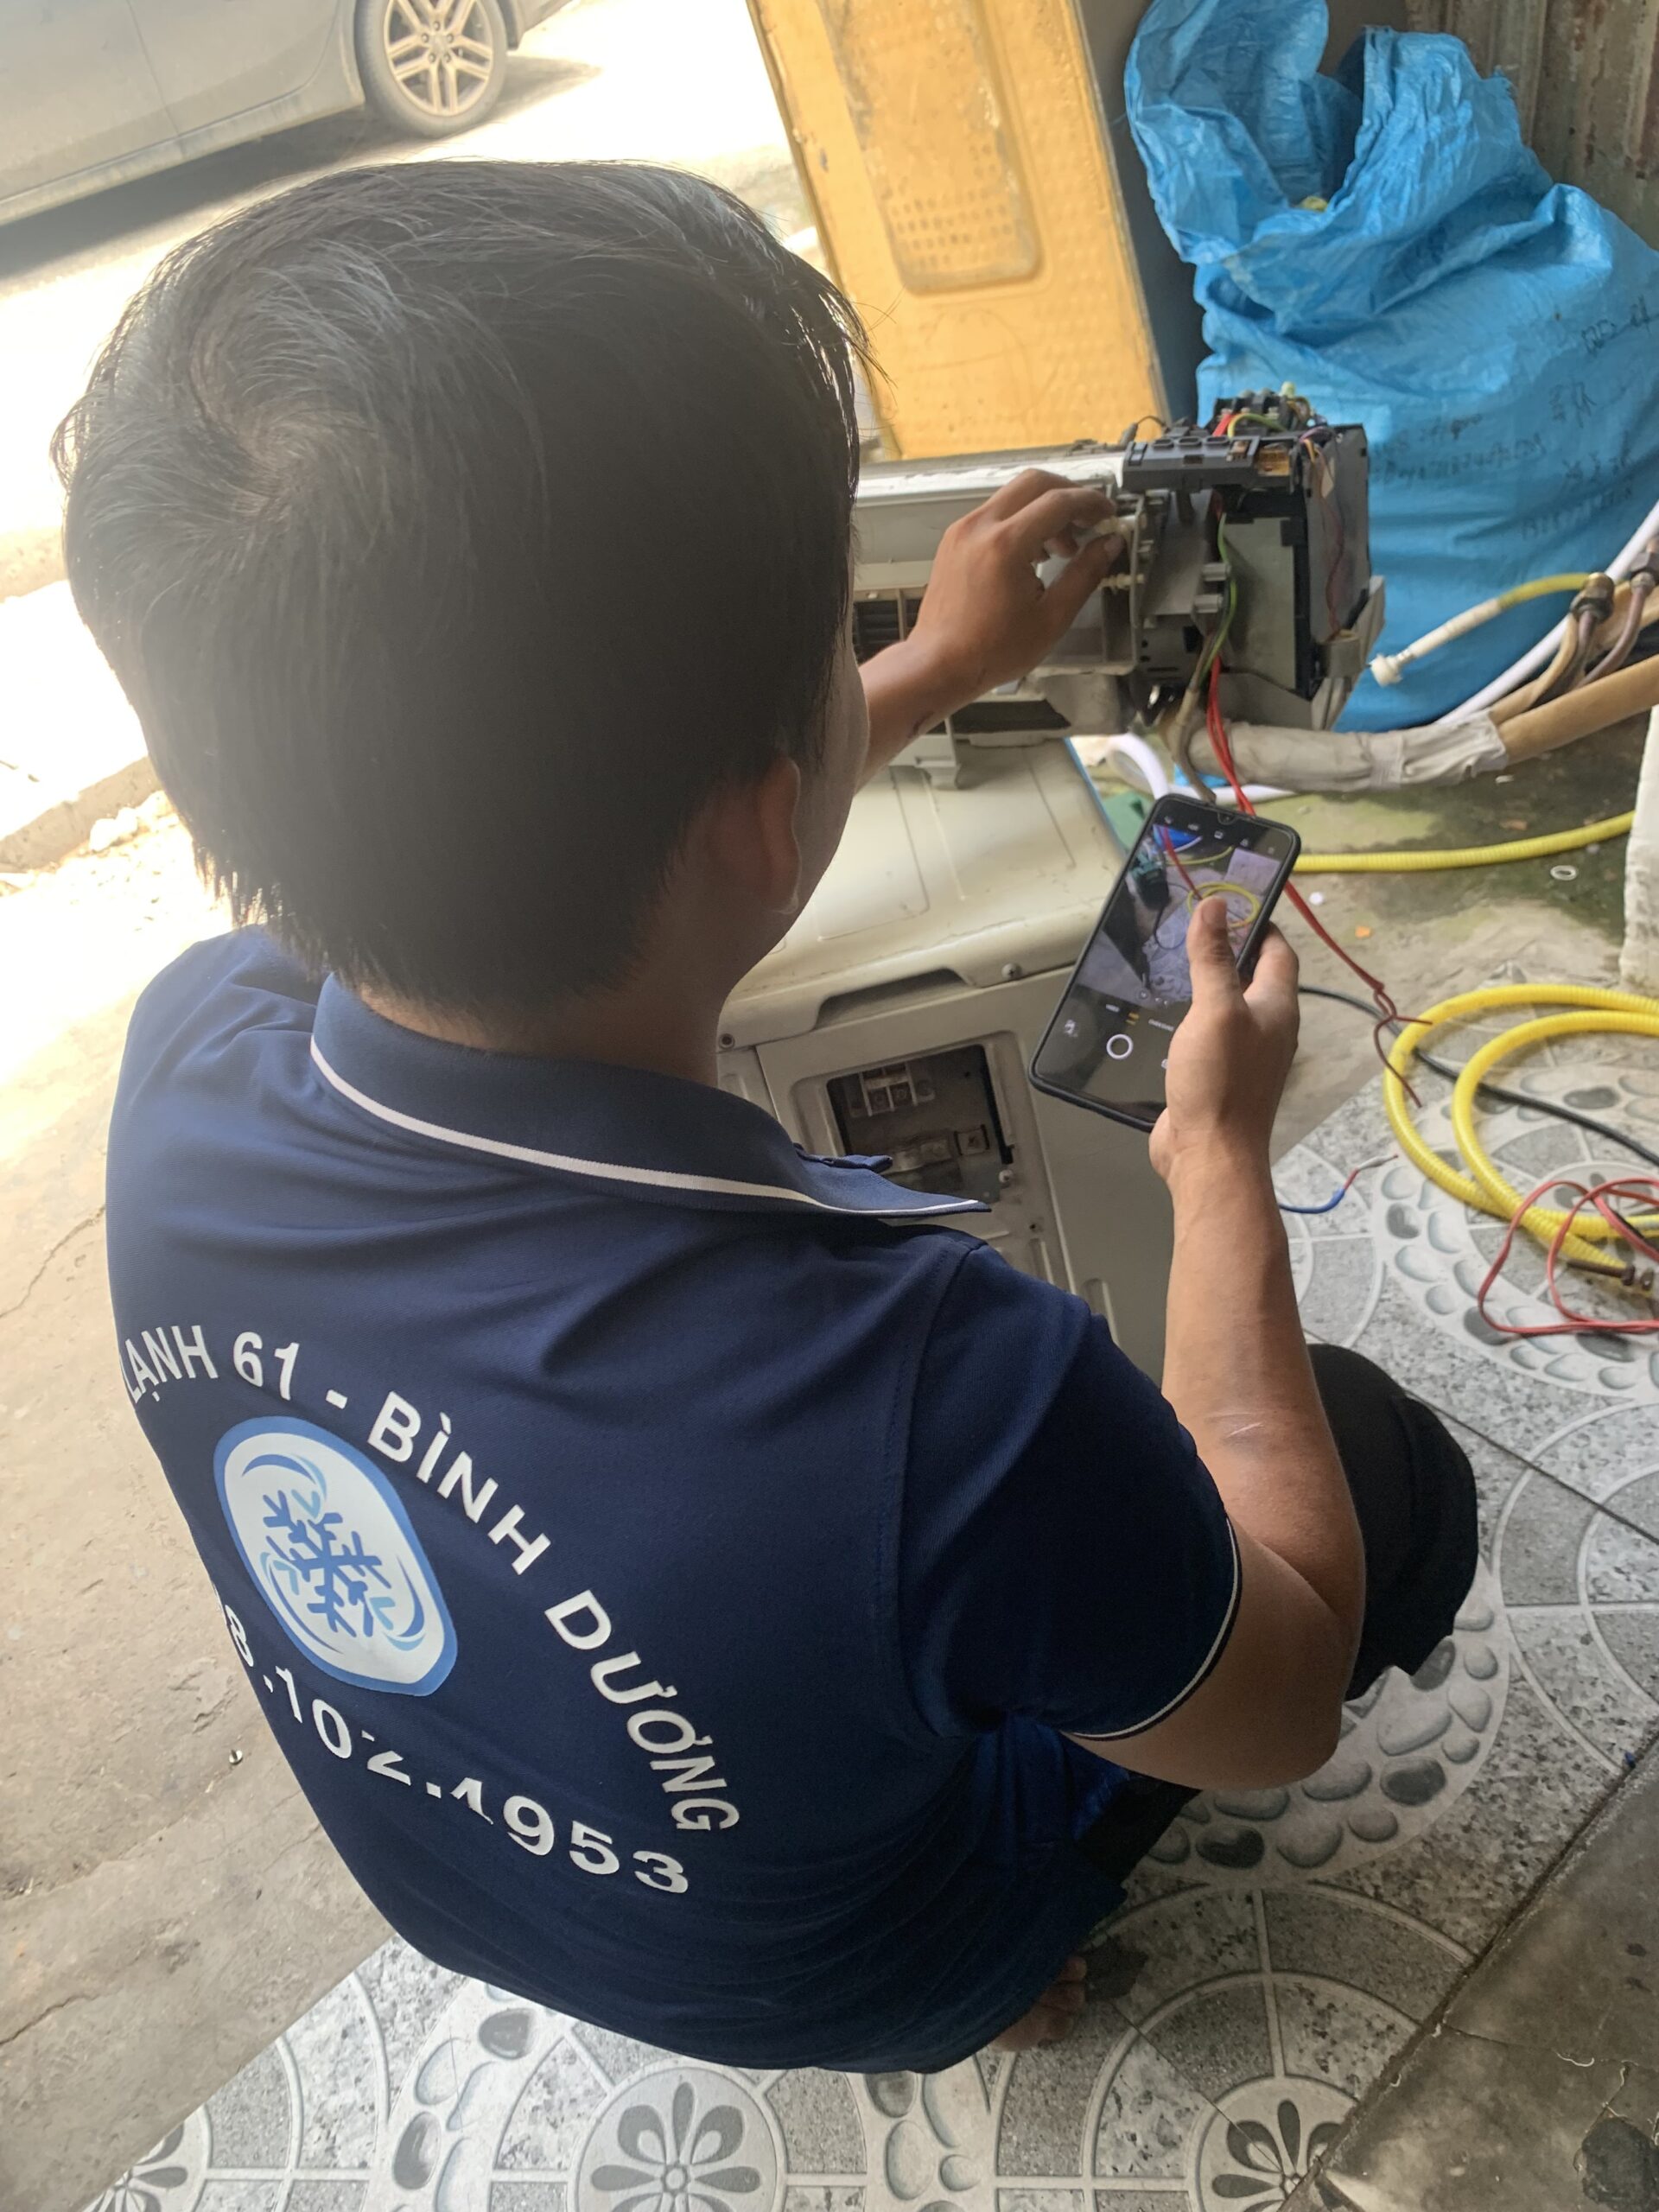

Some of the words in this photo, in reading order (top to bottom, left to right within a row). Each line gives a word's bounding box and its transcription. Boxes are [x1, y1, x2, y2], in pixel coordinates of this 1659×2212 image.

[119, 1325, 219, 1404] LẠNH
[232, 1331, 300, 1402] 61
[366, 1390, 552, 1576] BÌNH
[543, 1589, 741, 1831] DƯƠNG
